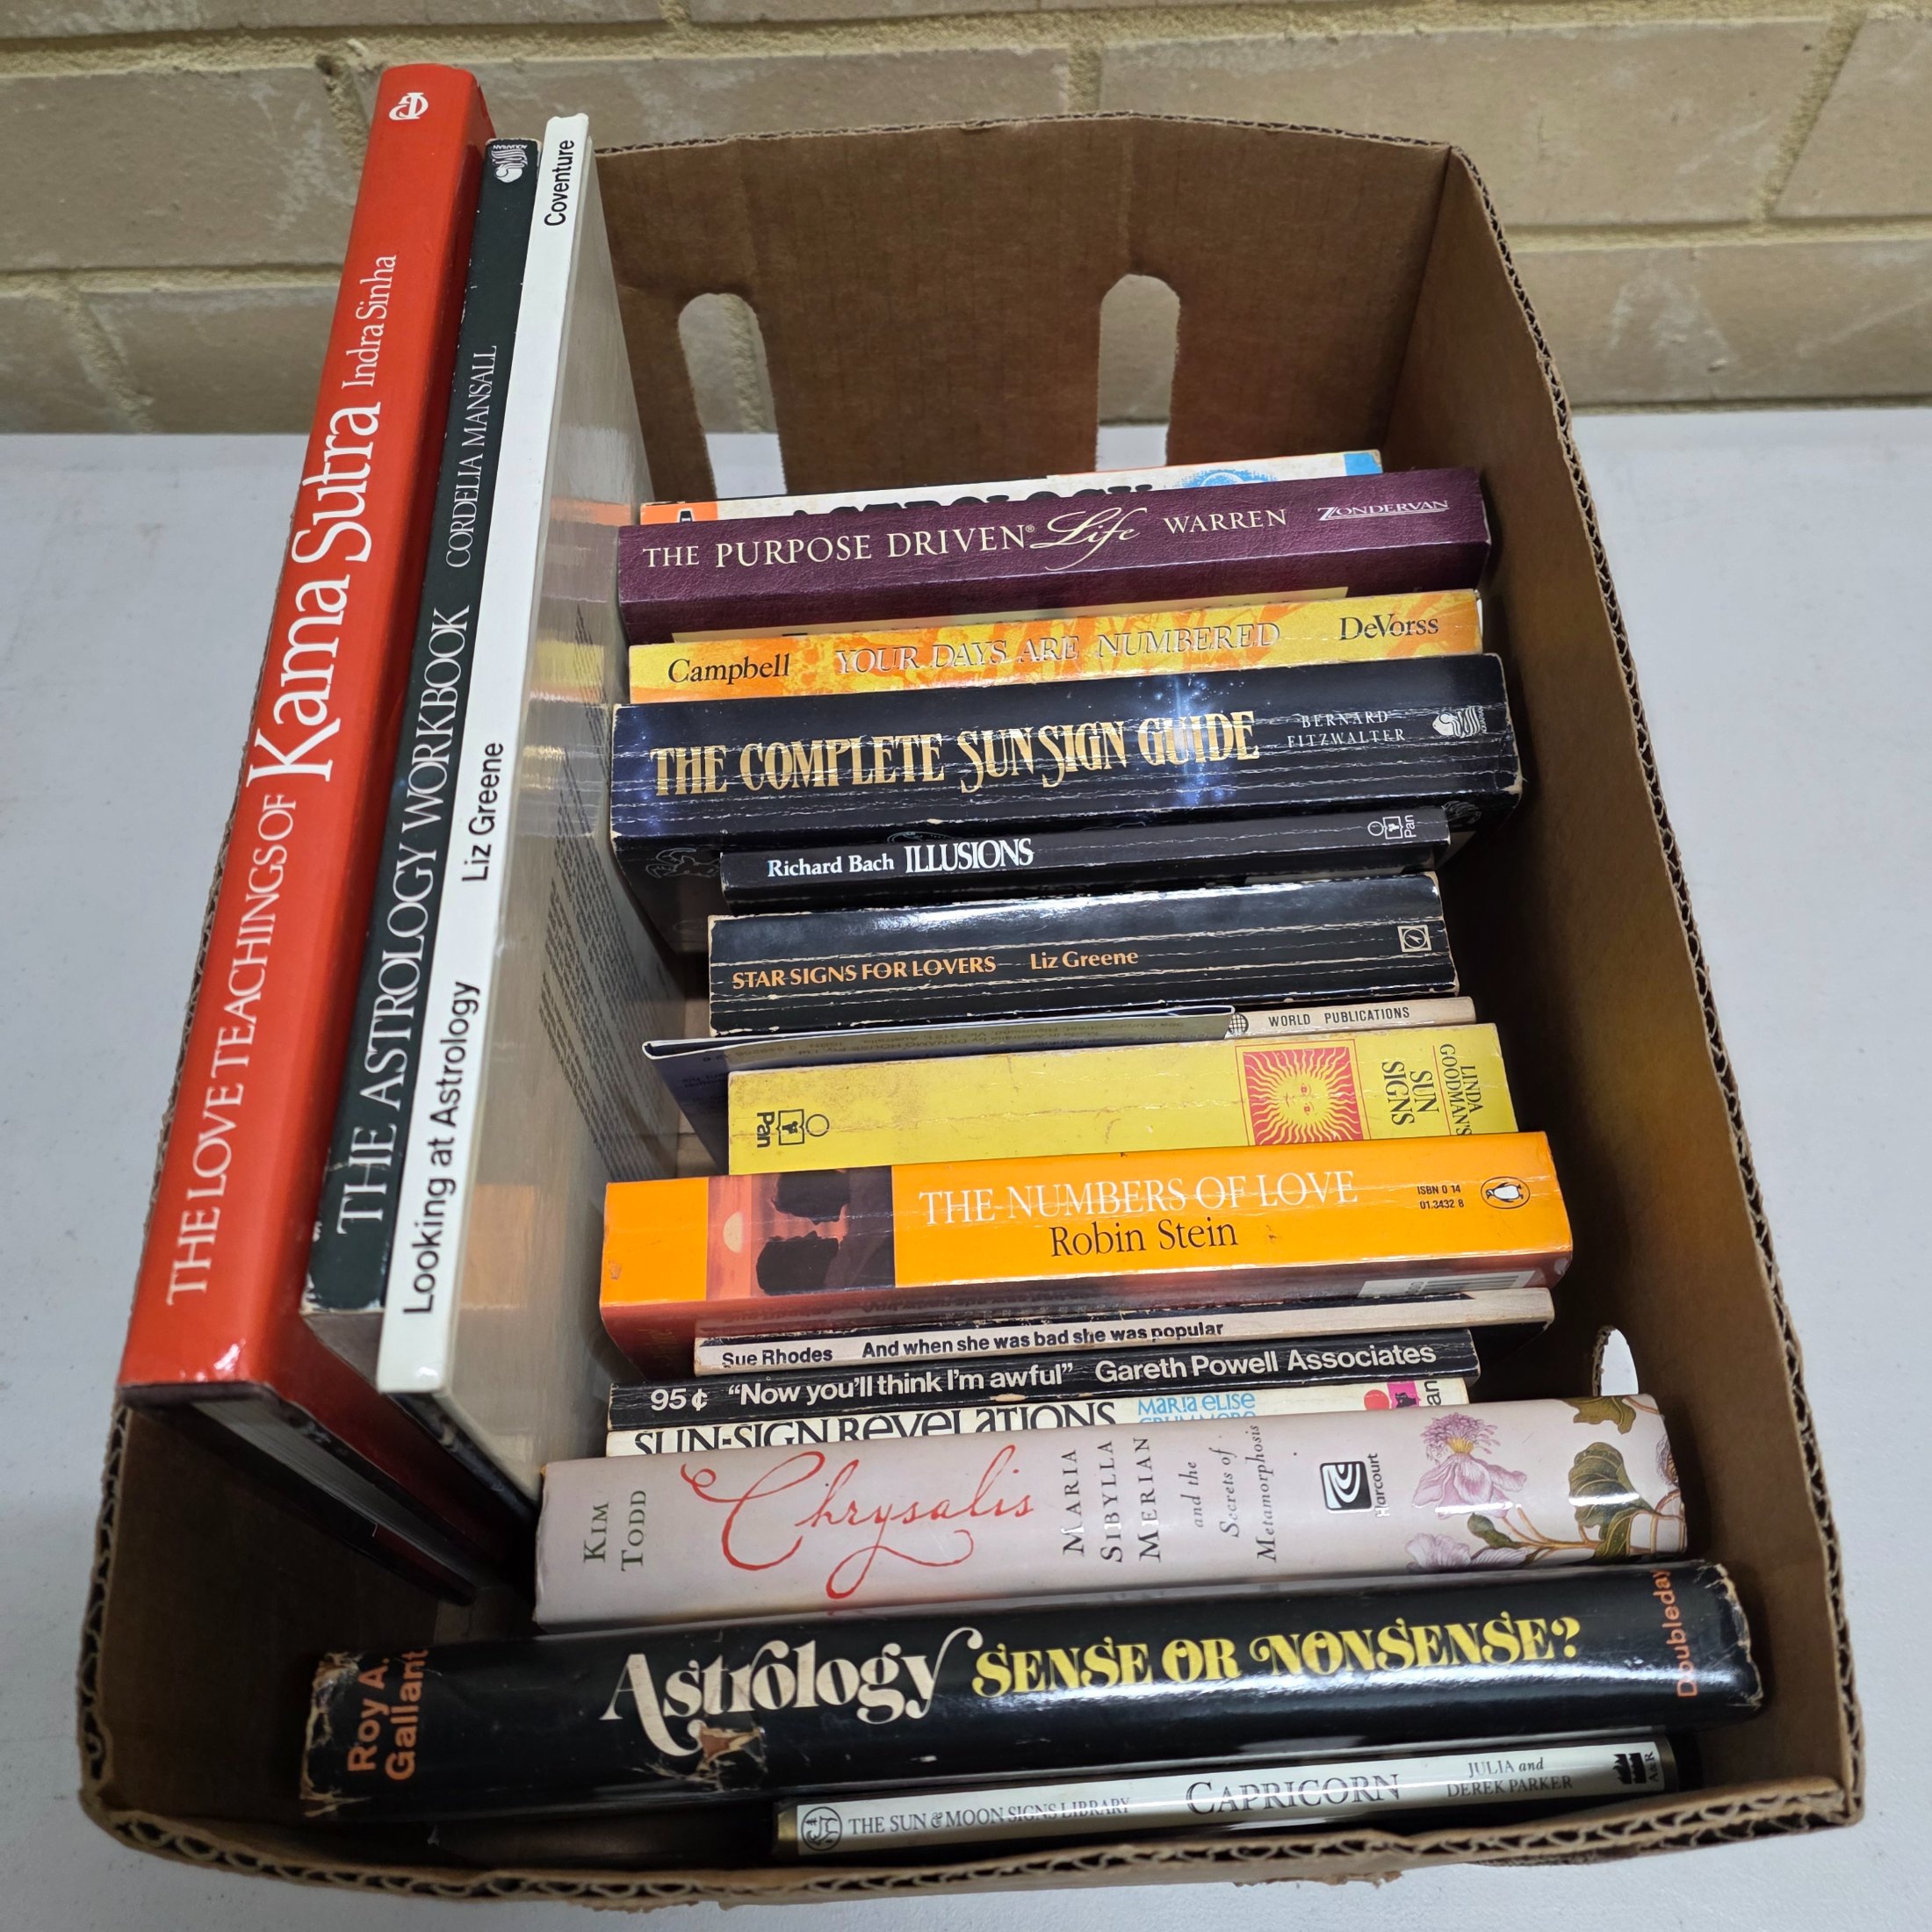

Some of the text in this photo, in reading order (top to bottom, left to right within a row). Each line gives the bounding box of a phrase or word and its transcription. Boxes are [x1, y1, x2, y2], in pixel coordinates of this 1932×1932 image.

[643, 546, 700, 567] THE
[715, 534, 872, 567] PURPOSE
[1029, 507, 1147, 571] Life
[1163, 508, 1287, 534] WARREN
[1316, 500, 1449, 521] ZONDERVAN
[668, 613, 1439, 685] Campbell YOUR DAYS ARE NUMBERED DeVorss
[403, 140, 575, 1316] Looking at Astrology Liz Greene Coventure
[1287, 729, 1406, 747] FITZWALTER
[1301, 710, 1389, 729] BERNARD
[166, 255, 397, 1306] THE LOVE TEACHINGS OF Kama Sutra Indra Sinha
[649, 710, 1260, 797] THE COMPLETE SUN SIGN GUIDE
[336, 345, 497, 1235] THE ASTROLOGY WORKBOOK CORDELIA MANSALL
[1403, 814, 1417, 839] Pan
[768, 838, 1034, 877] Richard Bach ILLUSIONS
[732, 949, 1139, 990] STAR SIGNS FOR LOVERS Liz Greene
[905, 1038, 967, 1048] DYNAMO
[1268, 1006, 1410, 1027] WORLD PUBLICATIONS
[850, 1042, 900, 1052] HOUSE
[1381, 1061, 1416, 1126] SIGNS
[1409, 1071, 1439, 1114] SUN
[1439, 1043, 1473, 1135] GOODMAN'S
[1460, 1064, 1484, 1114] LINDA
[756, 1112, 775, 1149] Pan
[918, 1170, 1359, 1225] THE NUMBERS OF LOVE
[1417, 1186, 1438, 1195] ISBN
[1452, 1184, 1461, 1194] 14
[1459, 1199, 1465, 1208] 8
[1049, 1216, 1238, 1258] Robin Stein
[722, 1322, 1223, 1367] Sue Rhodes And when she was bad she was popular
[876, 1372, 941, 1396] think
[1095, 1355, 1187, 1384] Gareth
[1193, 1351, 1278, 1376] Powell
[1288, 1345, 1437, 1372] Associates
[1424, 1380, 1439, 1406] an
[1062, 1449, 1085, 1556] MARIA
[1098, 1441, 1122, 1563] SIBYLLA
[1133, 1437, 1161, 1562] MERIAN
[1178, 1460, 1204, 1528] and the
[1208, 1446, 1240, 1538] Secrets of
[1246, 1425, 1277, 1563] Metamorphosis
[1369, 1453, 1390, 1517] Harcourt
[583, 1502, 609, 1563] KIM
[620, 1489, 647, 1572] TODD
[681, 1445, 1034, 1600] Chrysalis
[1652, 1568, 1698, 1698] Doubleday
[601, 1610, 1581, 1756] Astrology SENSE OR NONSENSE?
[347, 1658, 390, 1771] Roy A.
[385, 1649, 429, 1781] Gallant
[1185, 1773, 1401, 1815] CAPRICORN
[1446, 1775, 1573, 1799] DEREK PARKER
[1467, 1757, 1544, 1777] JULIA and
[1643, 1751, 1659, 1783] A&R
[848, 1798, 1131, 1835] THE SUN & MOON SIGNS LIBRARY
